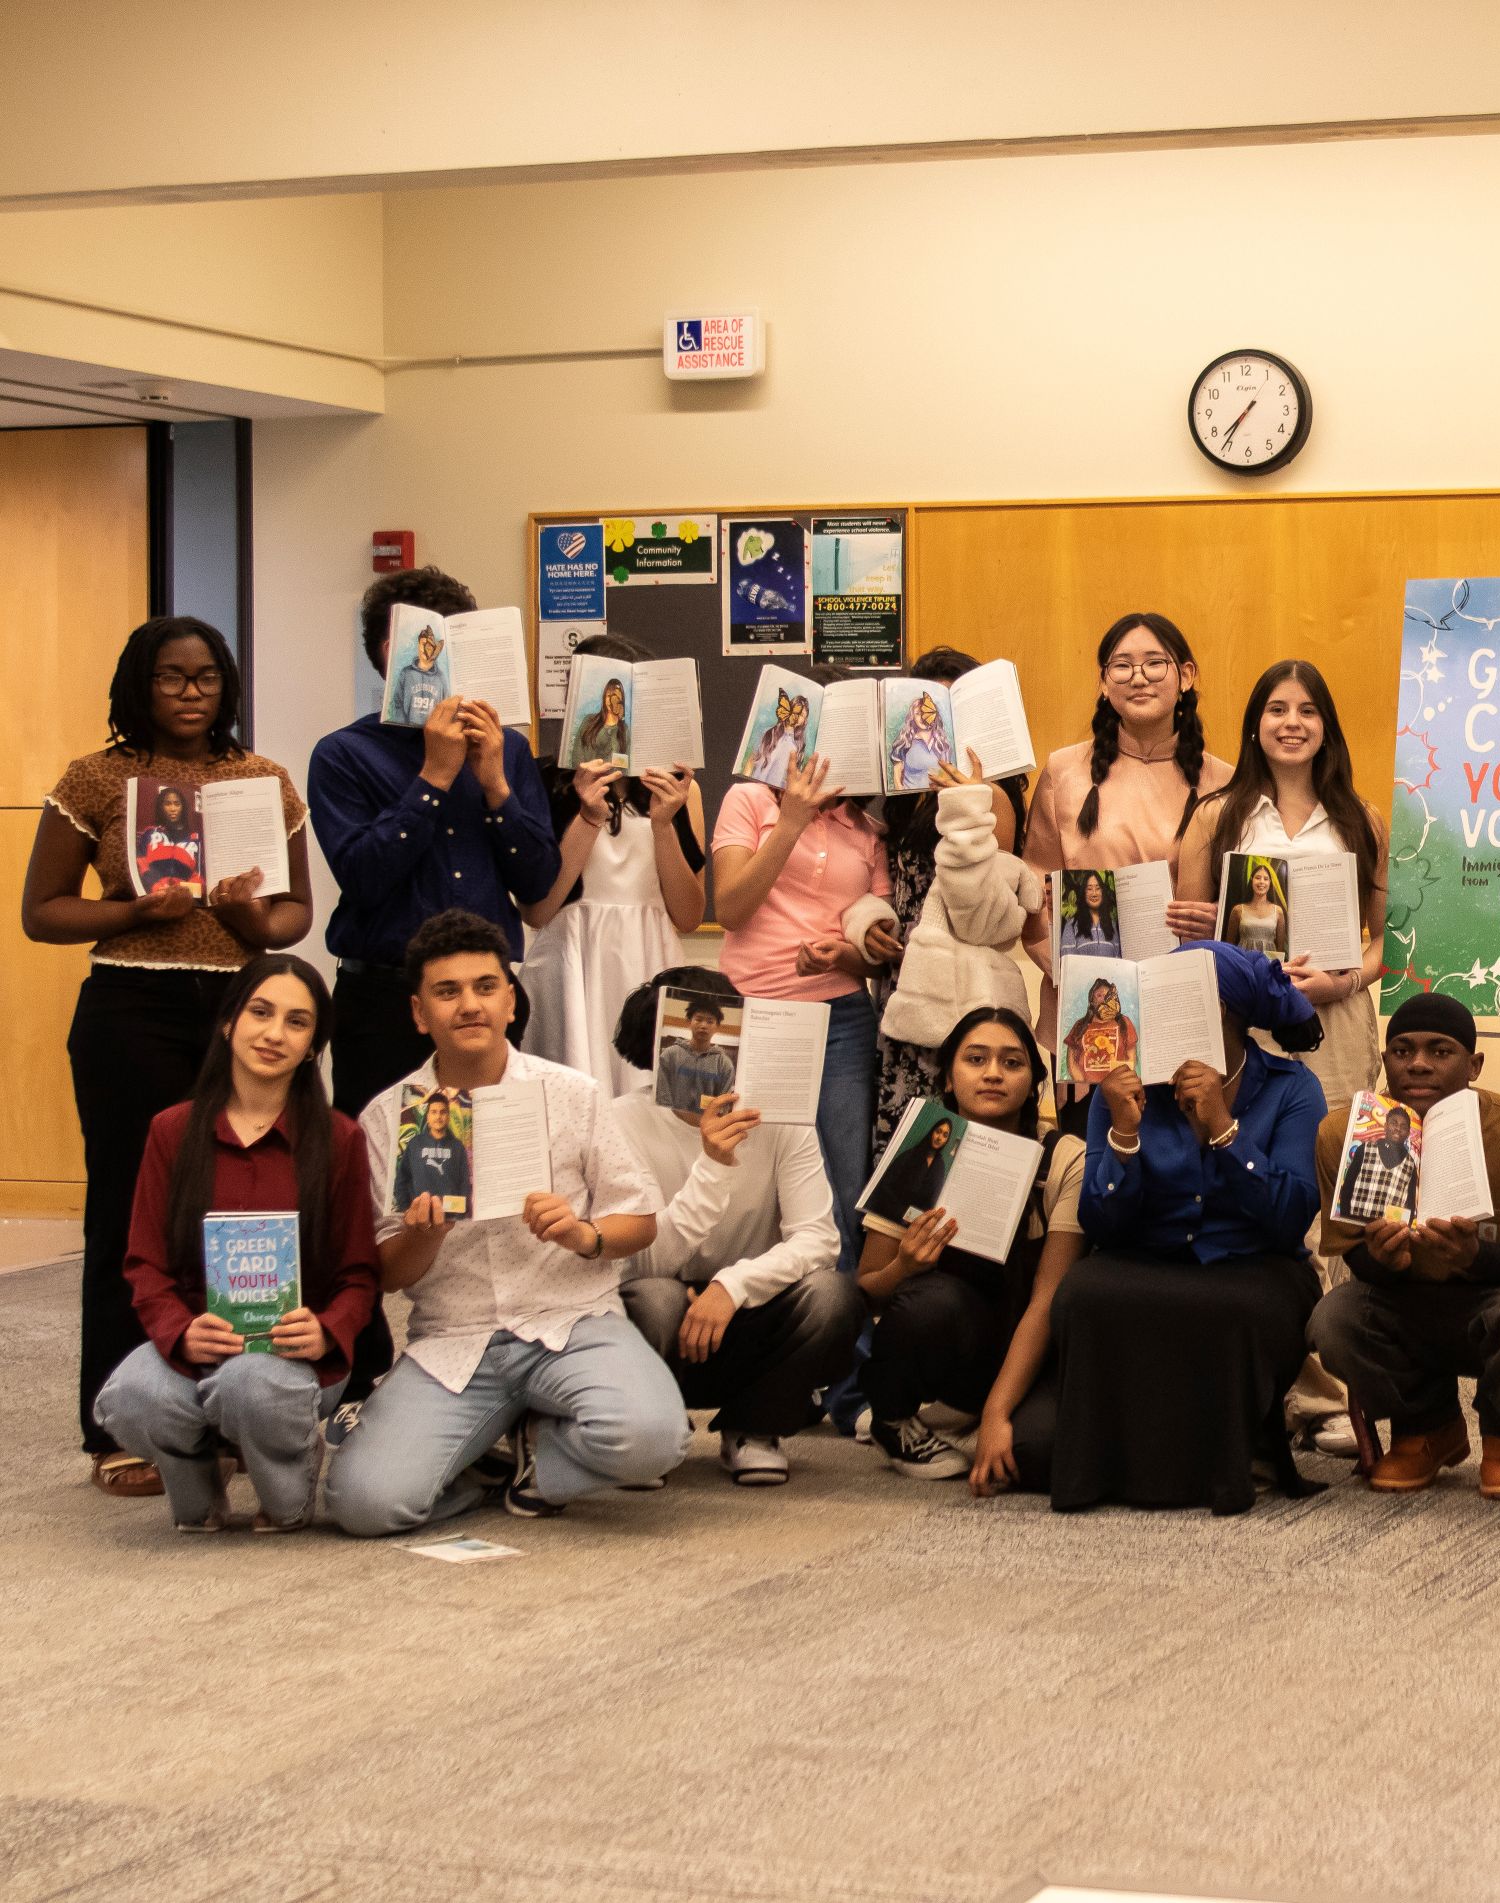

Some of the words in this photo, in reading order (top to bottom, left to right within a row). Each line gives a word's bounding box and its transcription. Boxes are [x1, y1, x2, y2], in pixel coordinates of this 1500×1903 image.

[704, 319, 729, 334] AREA
[731, 318, 744, 333] OF
[703, 335, 744, 351] RESCUE
[677, 352, 745, 369] ASSISTANCE
[1240, 364, 1252, 376] 12
[1265, 369, 1269, 381] 1
[1222, 371, 1231, 383] 11
[1208, 388, 1220, 400] 10
[1278, 384, 1286, 396] 2
[1205, 408, 1213, 420] 9
[1283, 404, 1290, 416] 3
[1210, 426, 1218, 438] 8
[1277, 423, 1285, 434] 4
[1265, 439, 1273, 451] 5
[1244, 446, 1252, 457] 6
[636, 545, 682, 557] Community
[545, 564, 566, 572] HATE
[566, 563, 584, 571] HAS
[584, 562, 599, 571] NO
[636, 557, 683, 568] Information
[547, 571, 572, 579] HOME
[573, 570, 597, 578] HERE.
[818, 602, 897, 611] 1-800-477-0024
[1461, 875, 1489, 887] from
[226, 1238, 277, 1257] GREEN
[226, 1255, 278, 1273] CARD
[228, 1274, 279, 1289] YOUTH
[228, 1289, 279, 1304] VOICES
